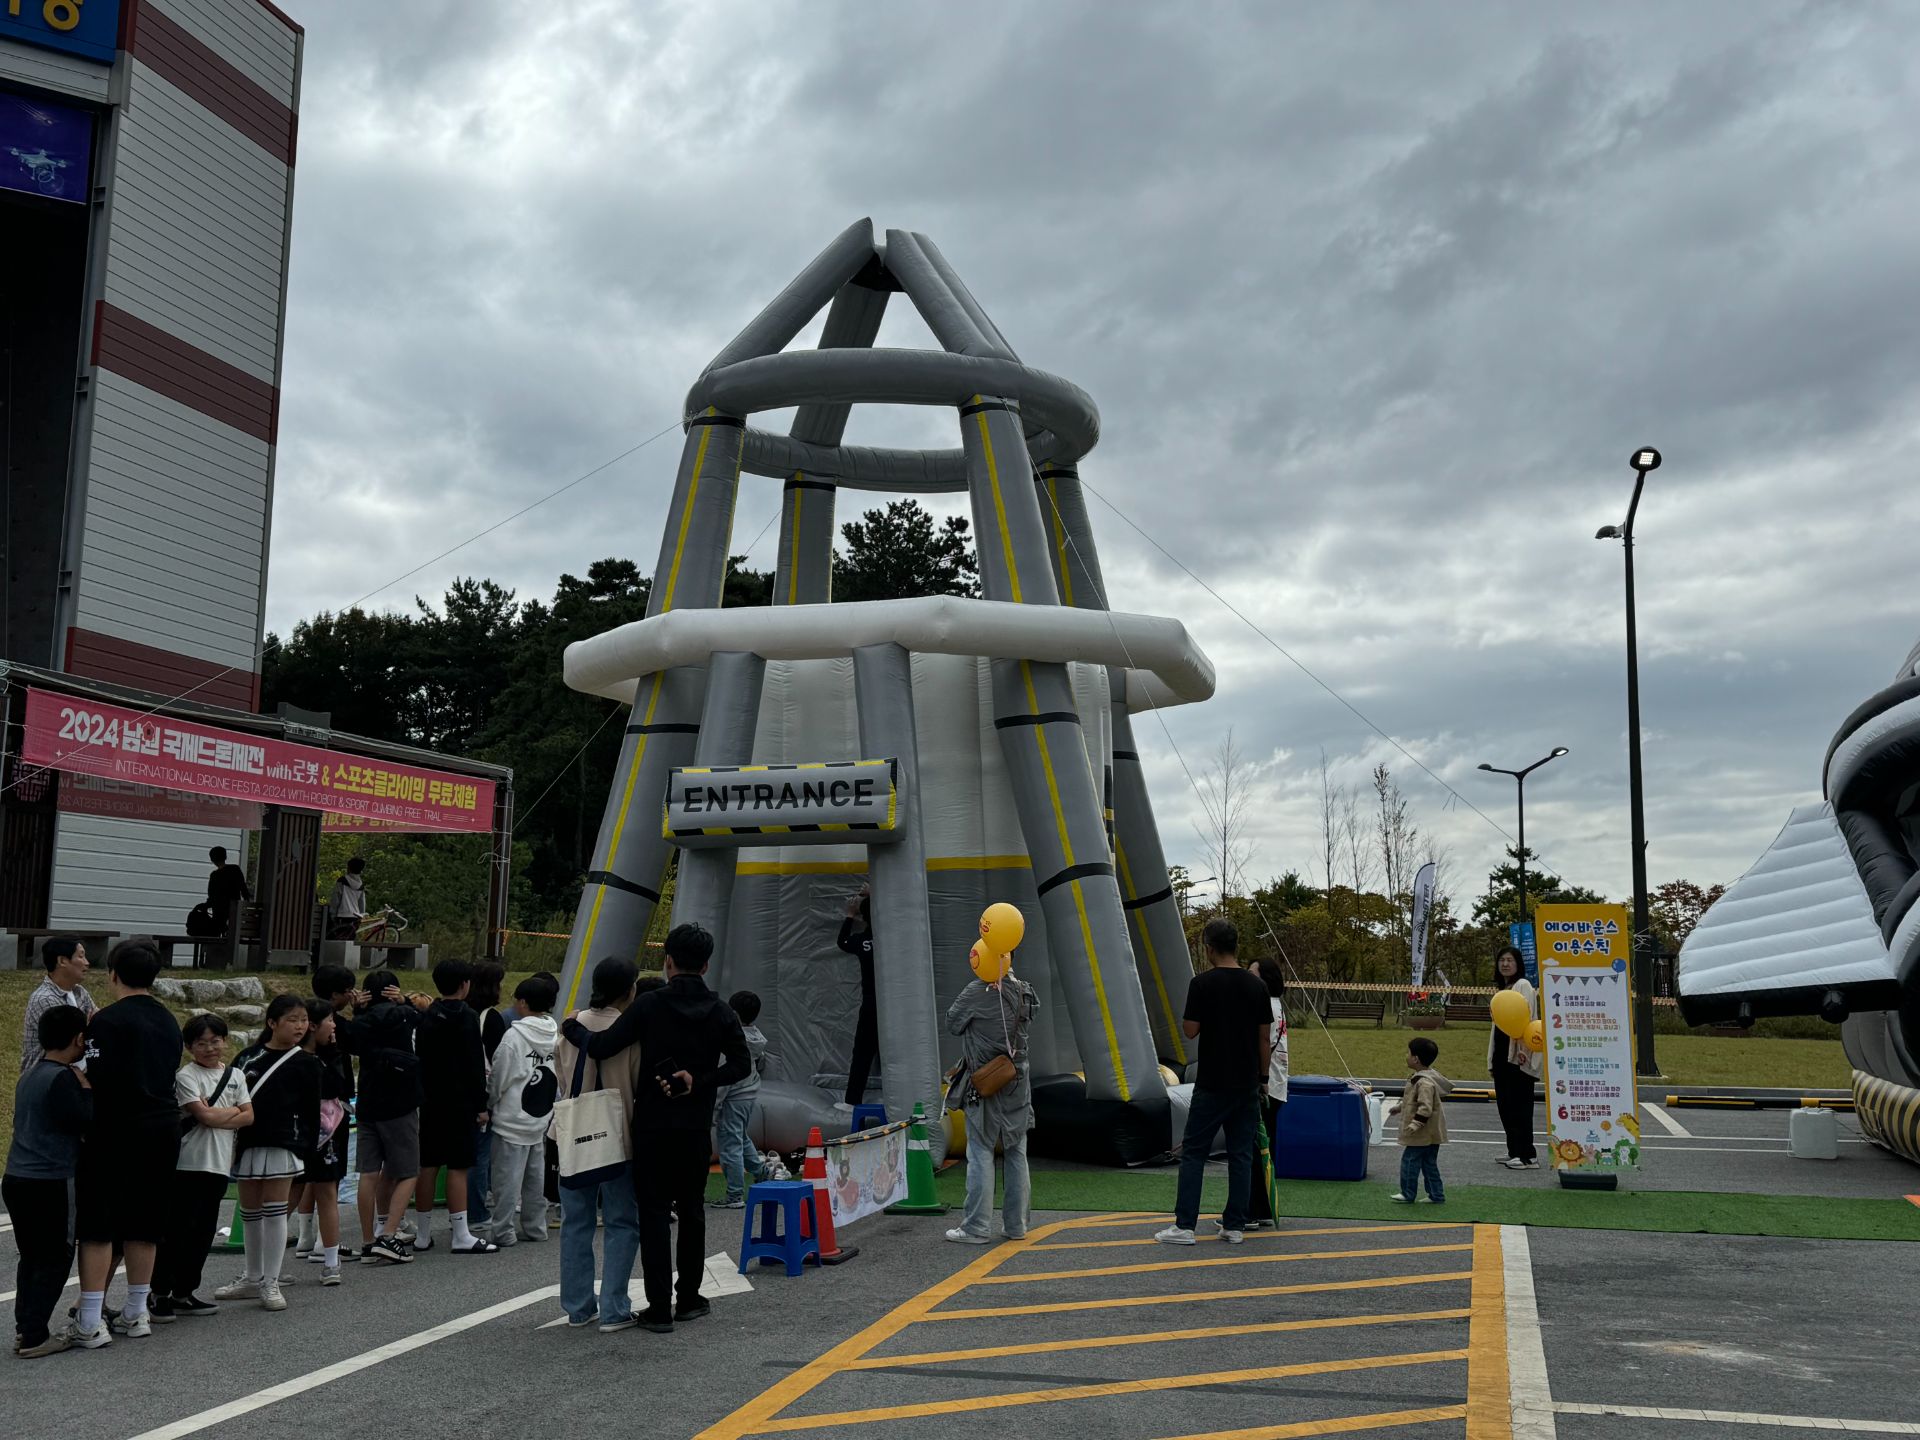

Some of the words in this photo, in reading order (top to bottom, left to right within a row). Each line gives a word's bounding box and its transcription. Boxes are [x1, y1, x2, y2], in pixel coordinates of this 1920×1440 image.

[58, 707, 119, 748] 2024
[162, 728, 265, 776] 국제드론제전
[321, 766, 330, 787] &
[333, 763, 426, 803] 스포츠클라이밍
[428, 780, 477, 810] 무료체험
[115, 760, 196, 786] INTERNATIONAL
[197, 773, 231, 791] DRONE
[231, 780, 261, 795] FESTA
[262, 784, 287, 799] 2024
[288, 788, 311, 802] WITH
[311, 793, 338, 807] ROBOT
[339, 798, 345, 808] &
[345, 799, 369, 813] SPORT
[404, 807, 421, 819] FREE
[424, 809, 441, 821] TRIAL
[683, 779, 874, 813] ENTRANCE
[1543, 919, 1619, 936] 에어바운스
[1553, 938, 1610, 955] 이용수칙
[1552, 992, 1561, 1007] 1
[1552, 1013, 1563, 1028] 2
[1553, 1036, 1565, 1051] 3
[1555, 1079, 1567, 1094] 5
[1557, 1105, 1569, 1120] 6
